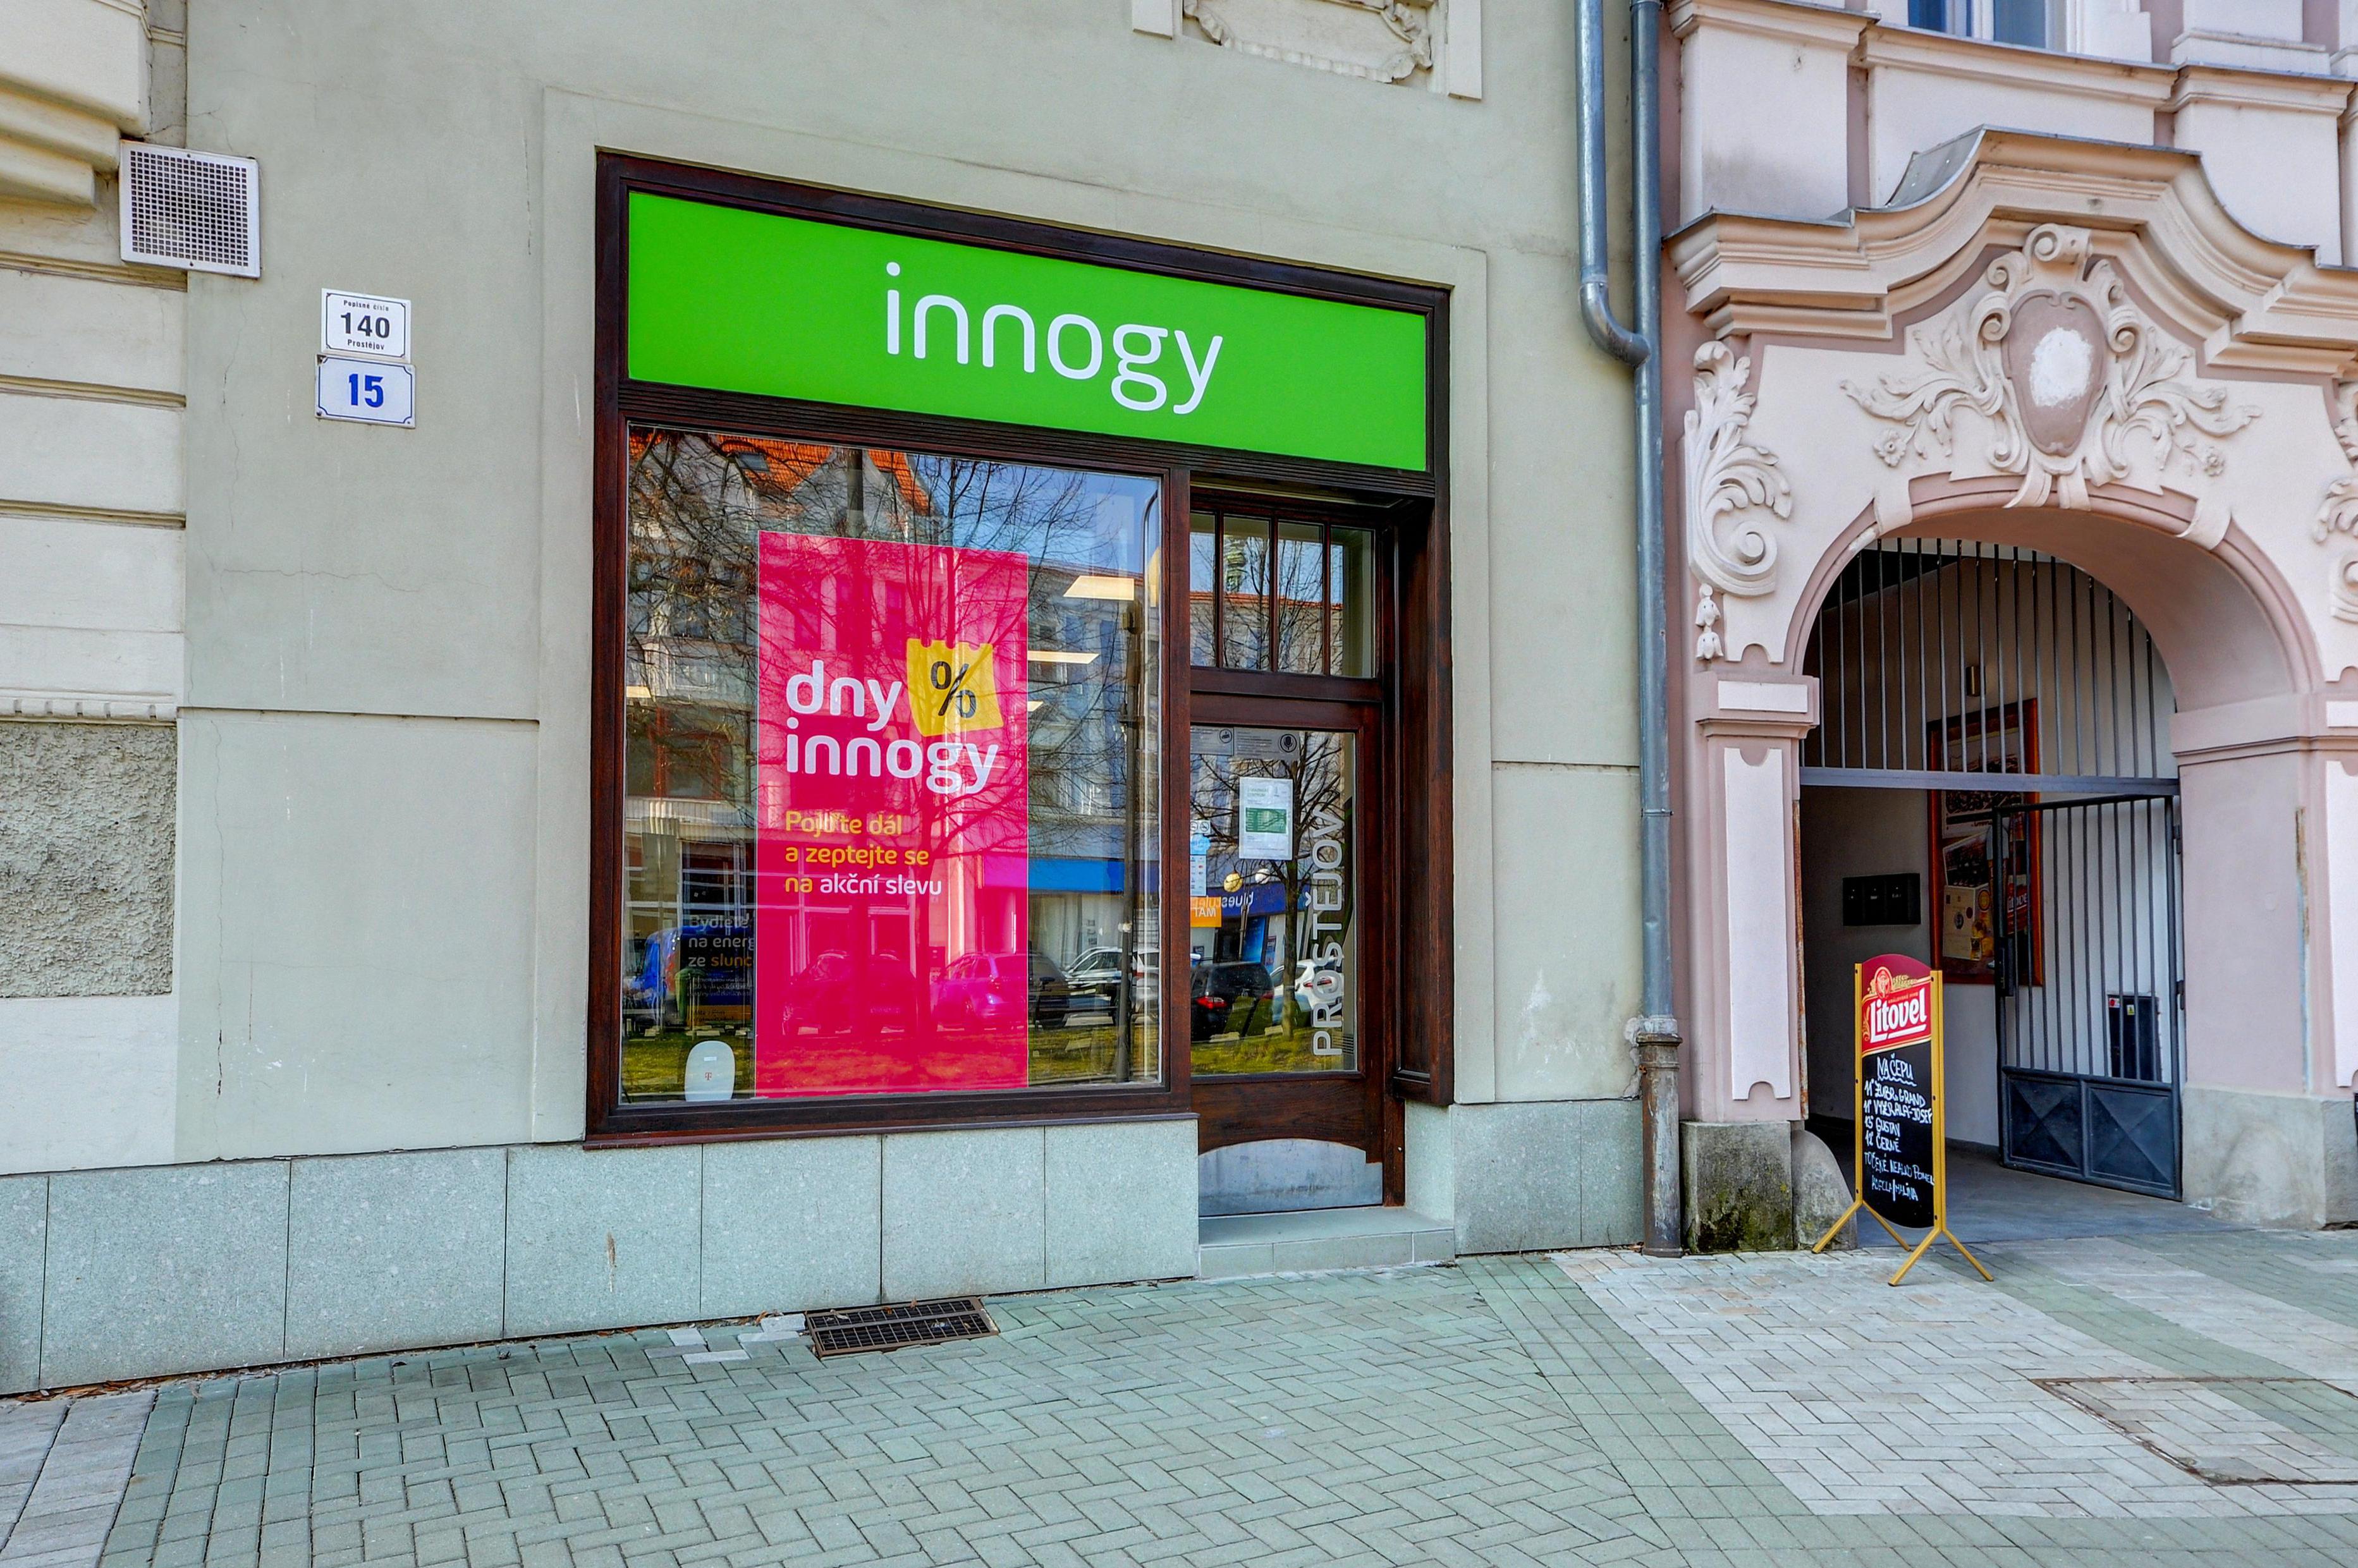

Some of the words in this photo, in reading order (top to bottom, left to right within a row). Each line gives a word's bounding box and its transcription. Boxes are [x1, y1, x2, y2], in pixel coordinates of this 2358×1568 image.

[343, 300, 370, 309] Popisné
[340, 312, 390, 338] 140
[886, 261, 1224, 415] innogy
[347, 339, 385, 350] Prostějov
[349, 373, 384, 408] 15
[786, 659, 903, 732] dny
[786, 717, 999, 794] innogy
[785, 811, 862, 838] Pojďte
[869, 814, 902, 836] dál
[785, 846, 798, 862] a
[805, 844, 898, 869] zeptejte
[904, 849, 929, 865] se
[785, 877, 813, 893] na
[820, 873, 881, 894] akční
[886, 873, 942, 895] slevu
[688, 937, 707, 948] na
[1305, 806, 1344, 1057] PROSTĚJOV
[688, 956, 706, 967] ze
[711, 953, 755, 967] slunc
[1870, 987, 1927, 1043] Litovel
[1898, 1088, 1926, 1108] GRAND
